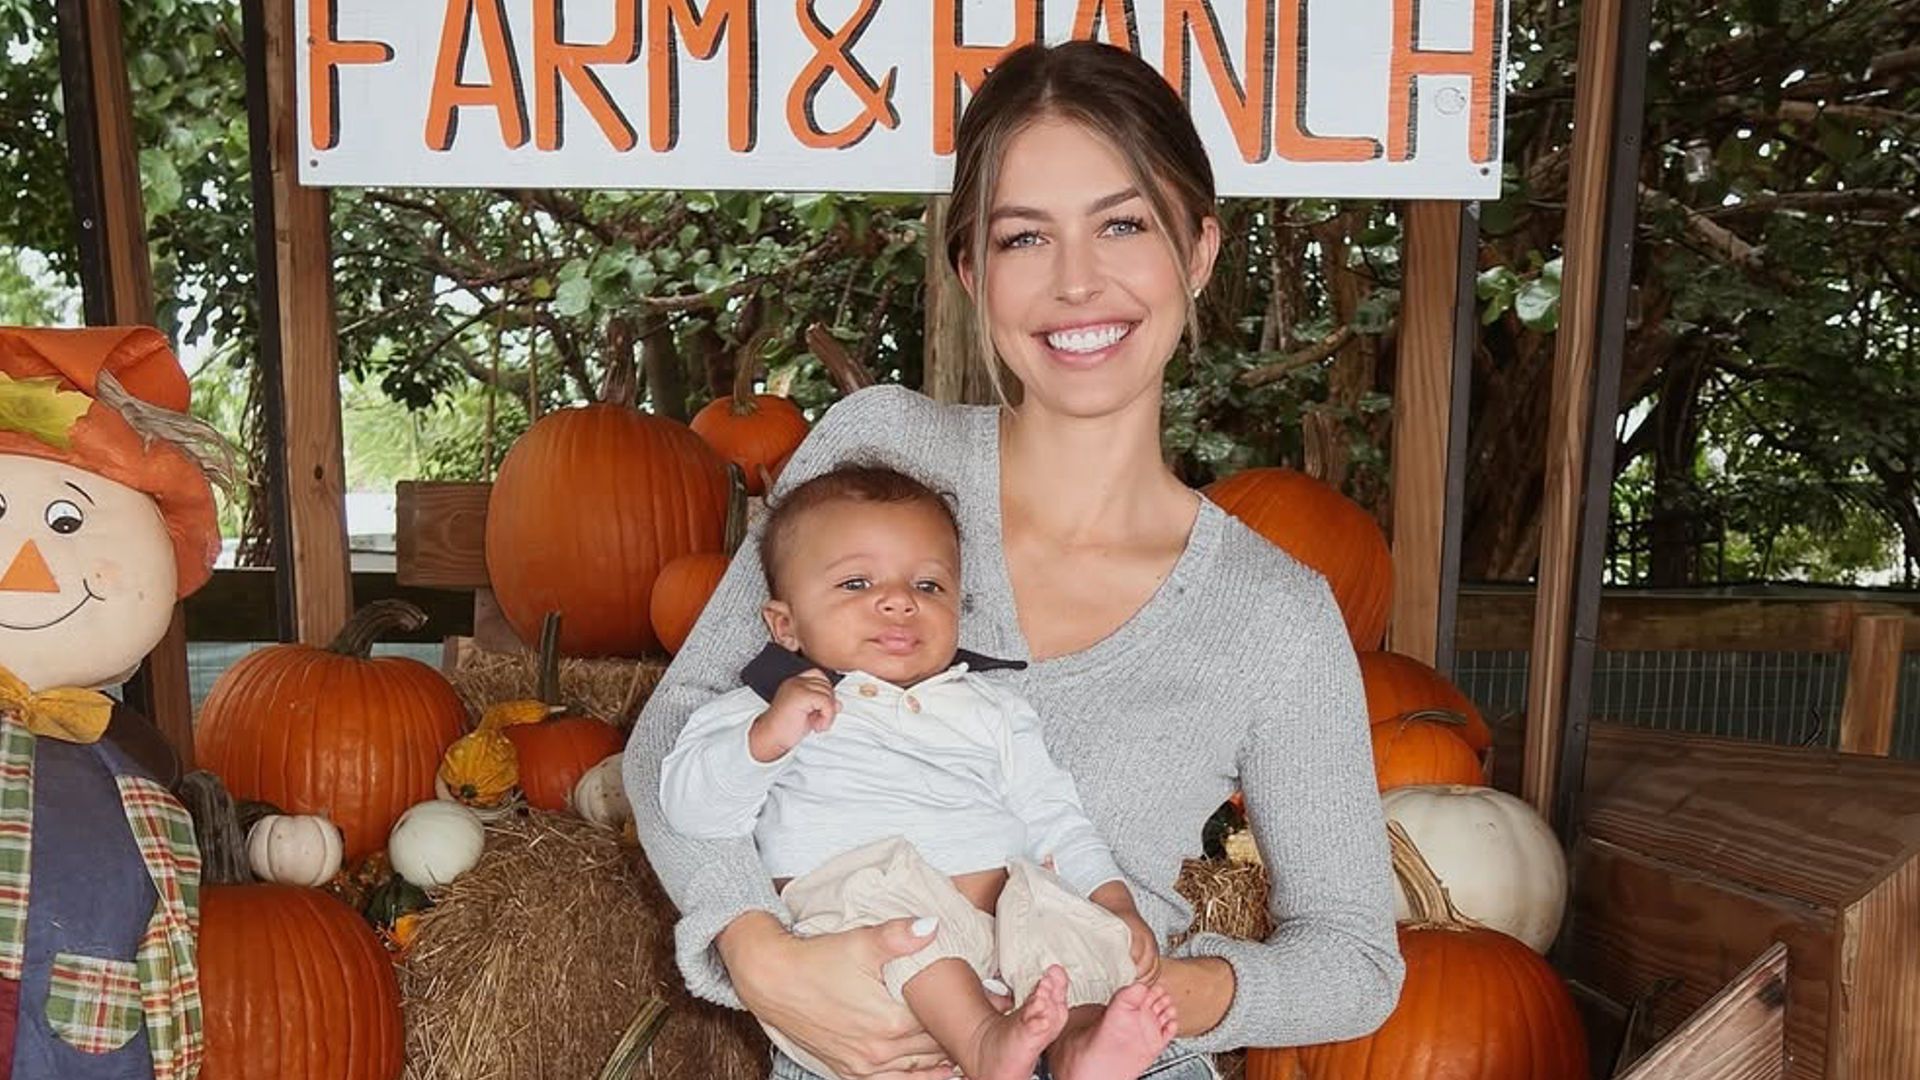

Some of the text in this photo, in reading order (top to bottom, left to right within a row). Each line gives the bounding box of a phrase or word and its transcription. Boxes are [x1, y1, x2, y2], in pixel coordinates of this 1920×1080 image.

[309, 0, 1501, 164] FARM & RNCH
